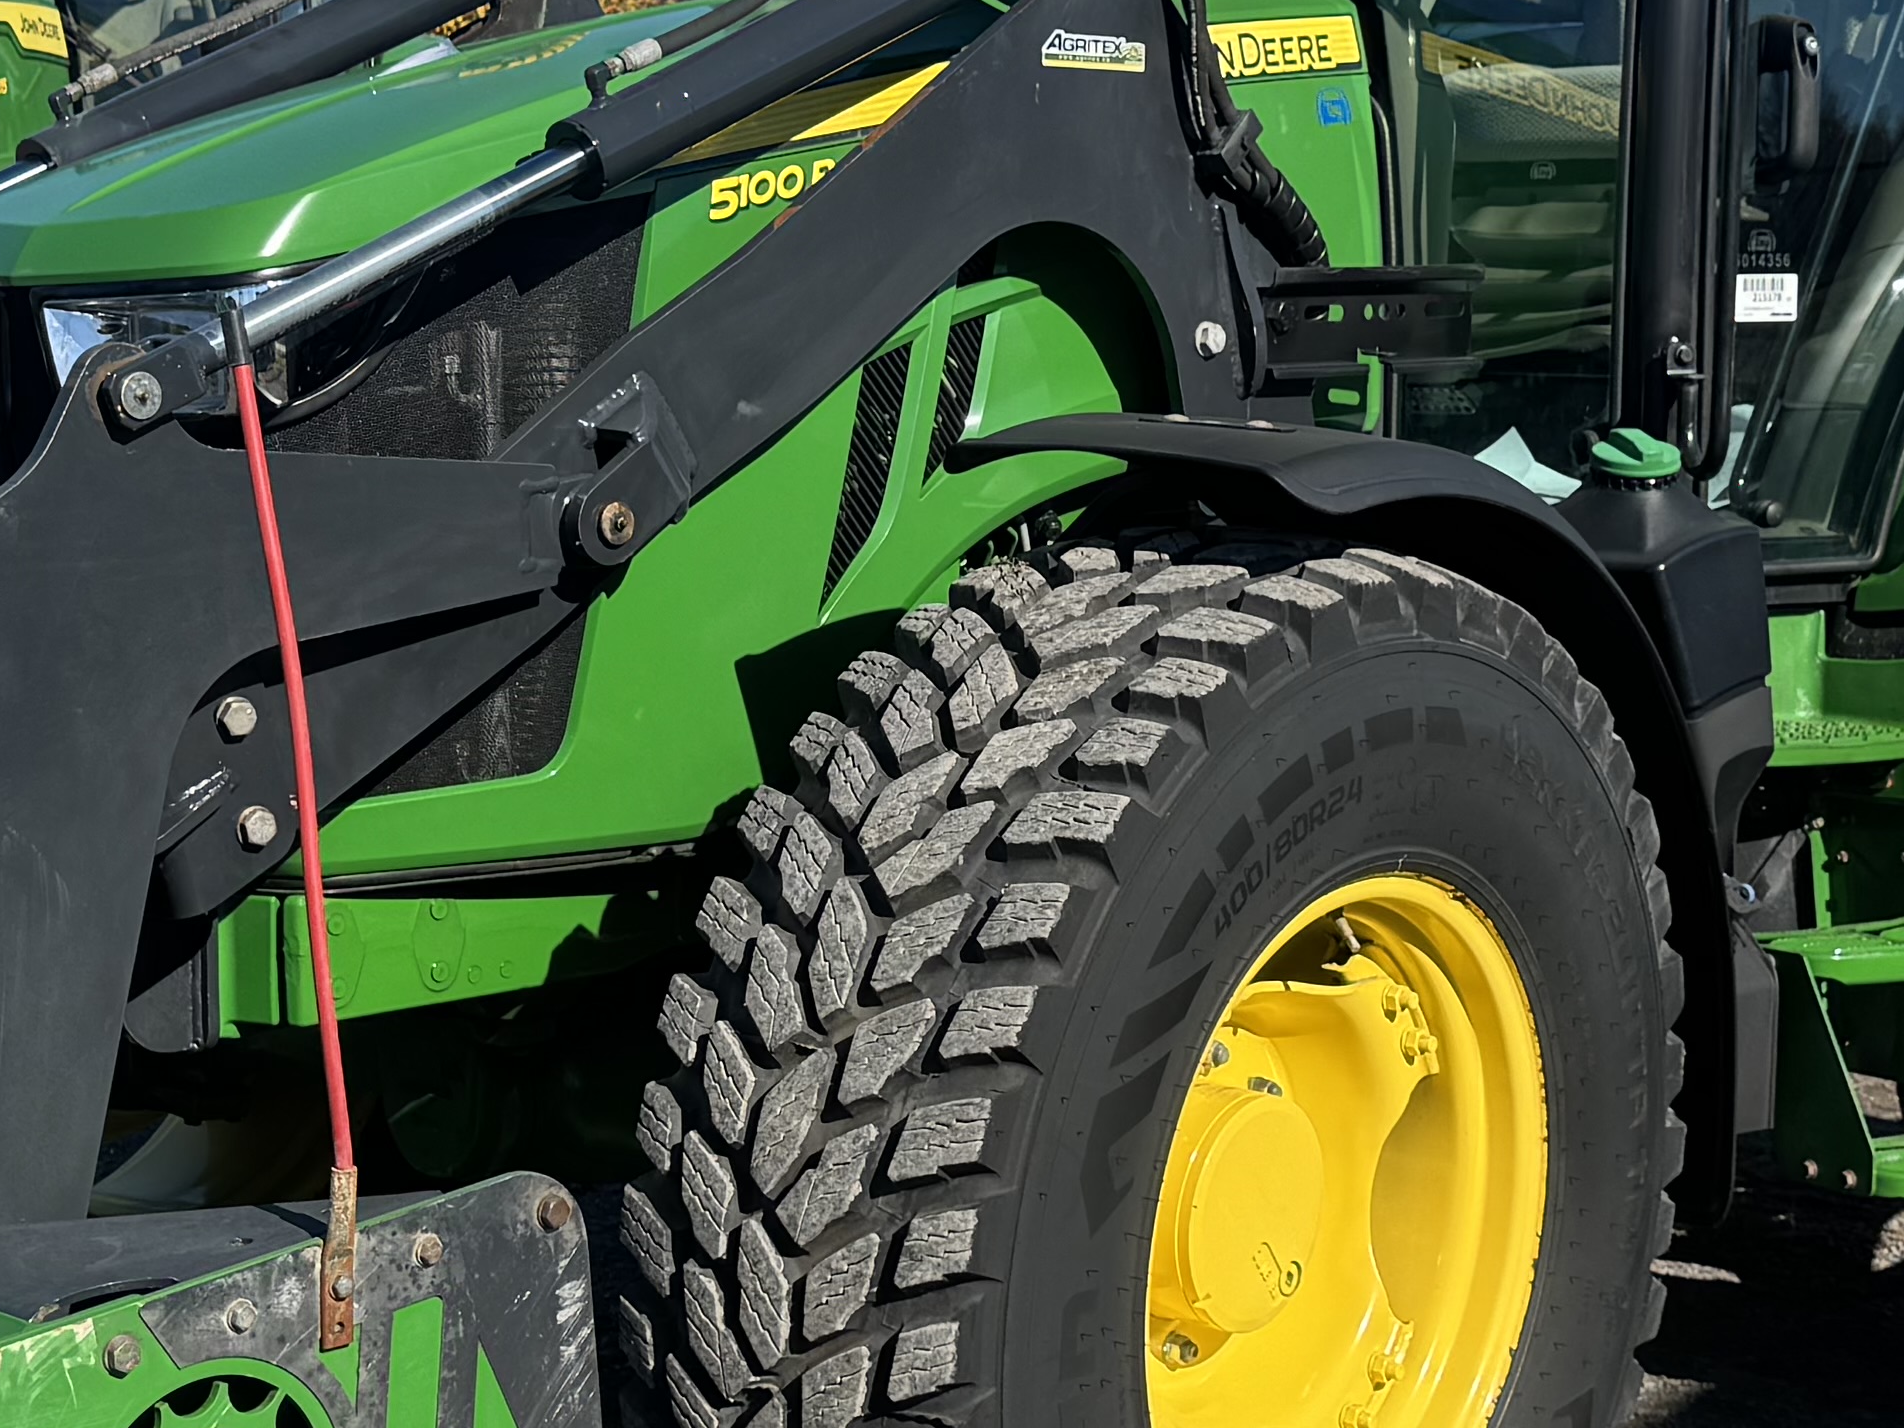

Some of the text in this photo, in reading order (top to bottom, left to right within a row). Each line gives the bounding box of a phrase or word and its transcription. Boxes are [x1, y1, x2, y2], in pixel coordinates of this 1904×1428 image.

[1046, 33, 1123, 55] AGRITEX
[1238, 33, 1332, 68] DEERE
[1215, 776, 1363, 939] 400/80R24
